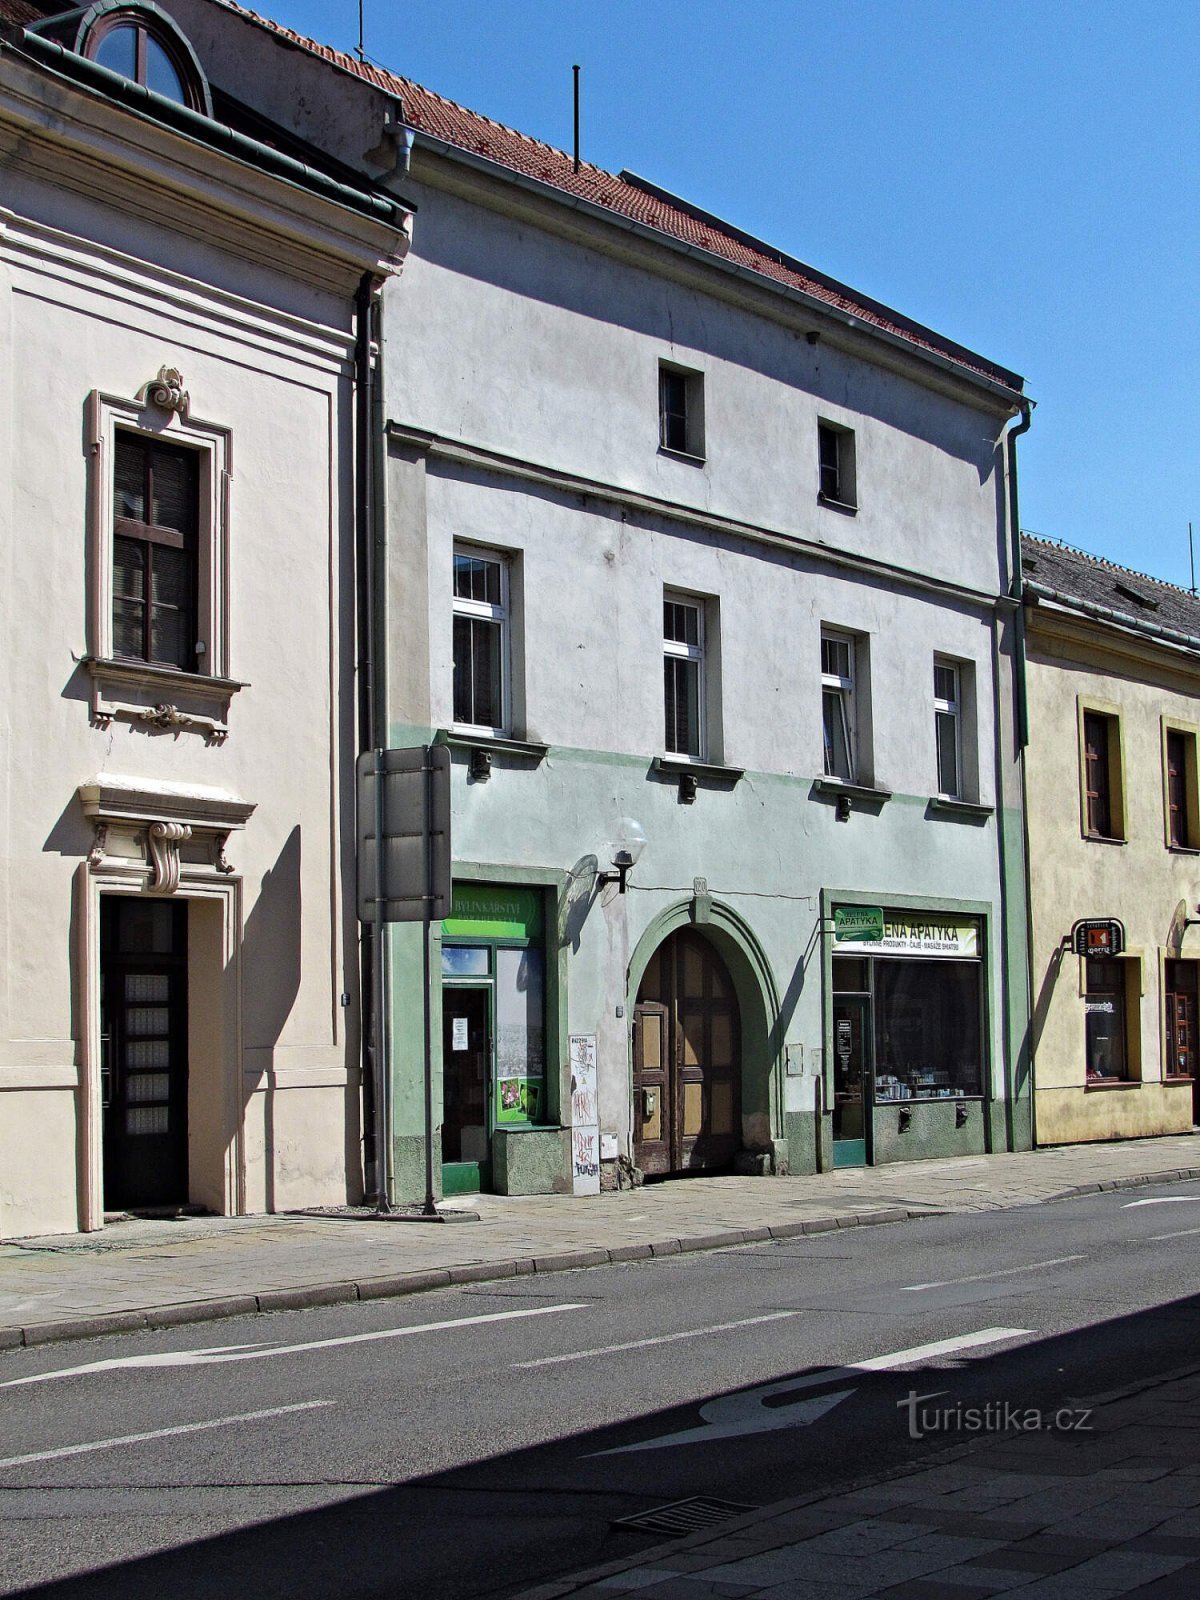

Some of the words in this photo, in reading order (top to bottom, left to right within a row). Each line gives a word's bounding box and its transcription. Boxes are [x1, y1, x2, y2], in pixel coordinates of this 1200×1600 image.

[839, 917, 878, 926] APATYKA
[884, 919, 907, 938] ENÁ
[910, 923, 959, 941] APATYKA
[883, 940, 906, 948] PRODUKTY
